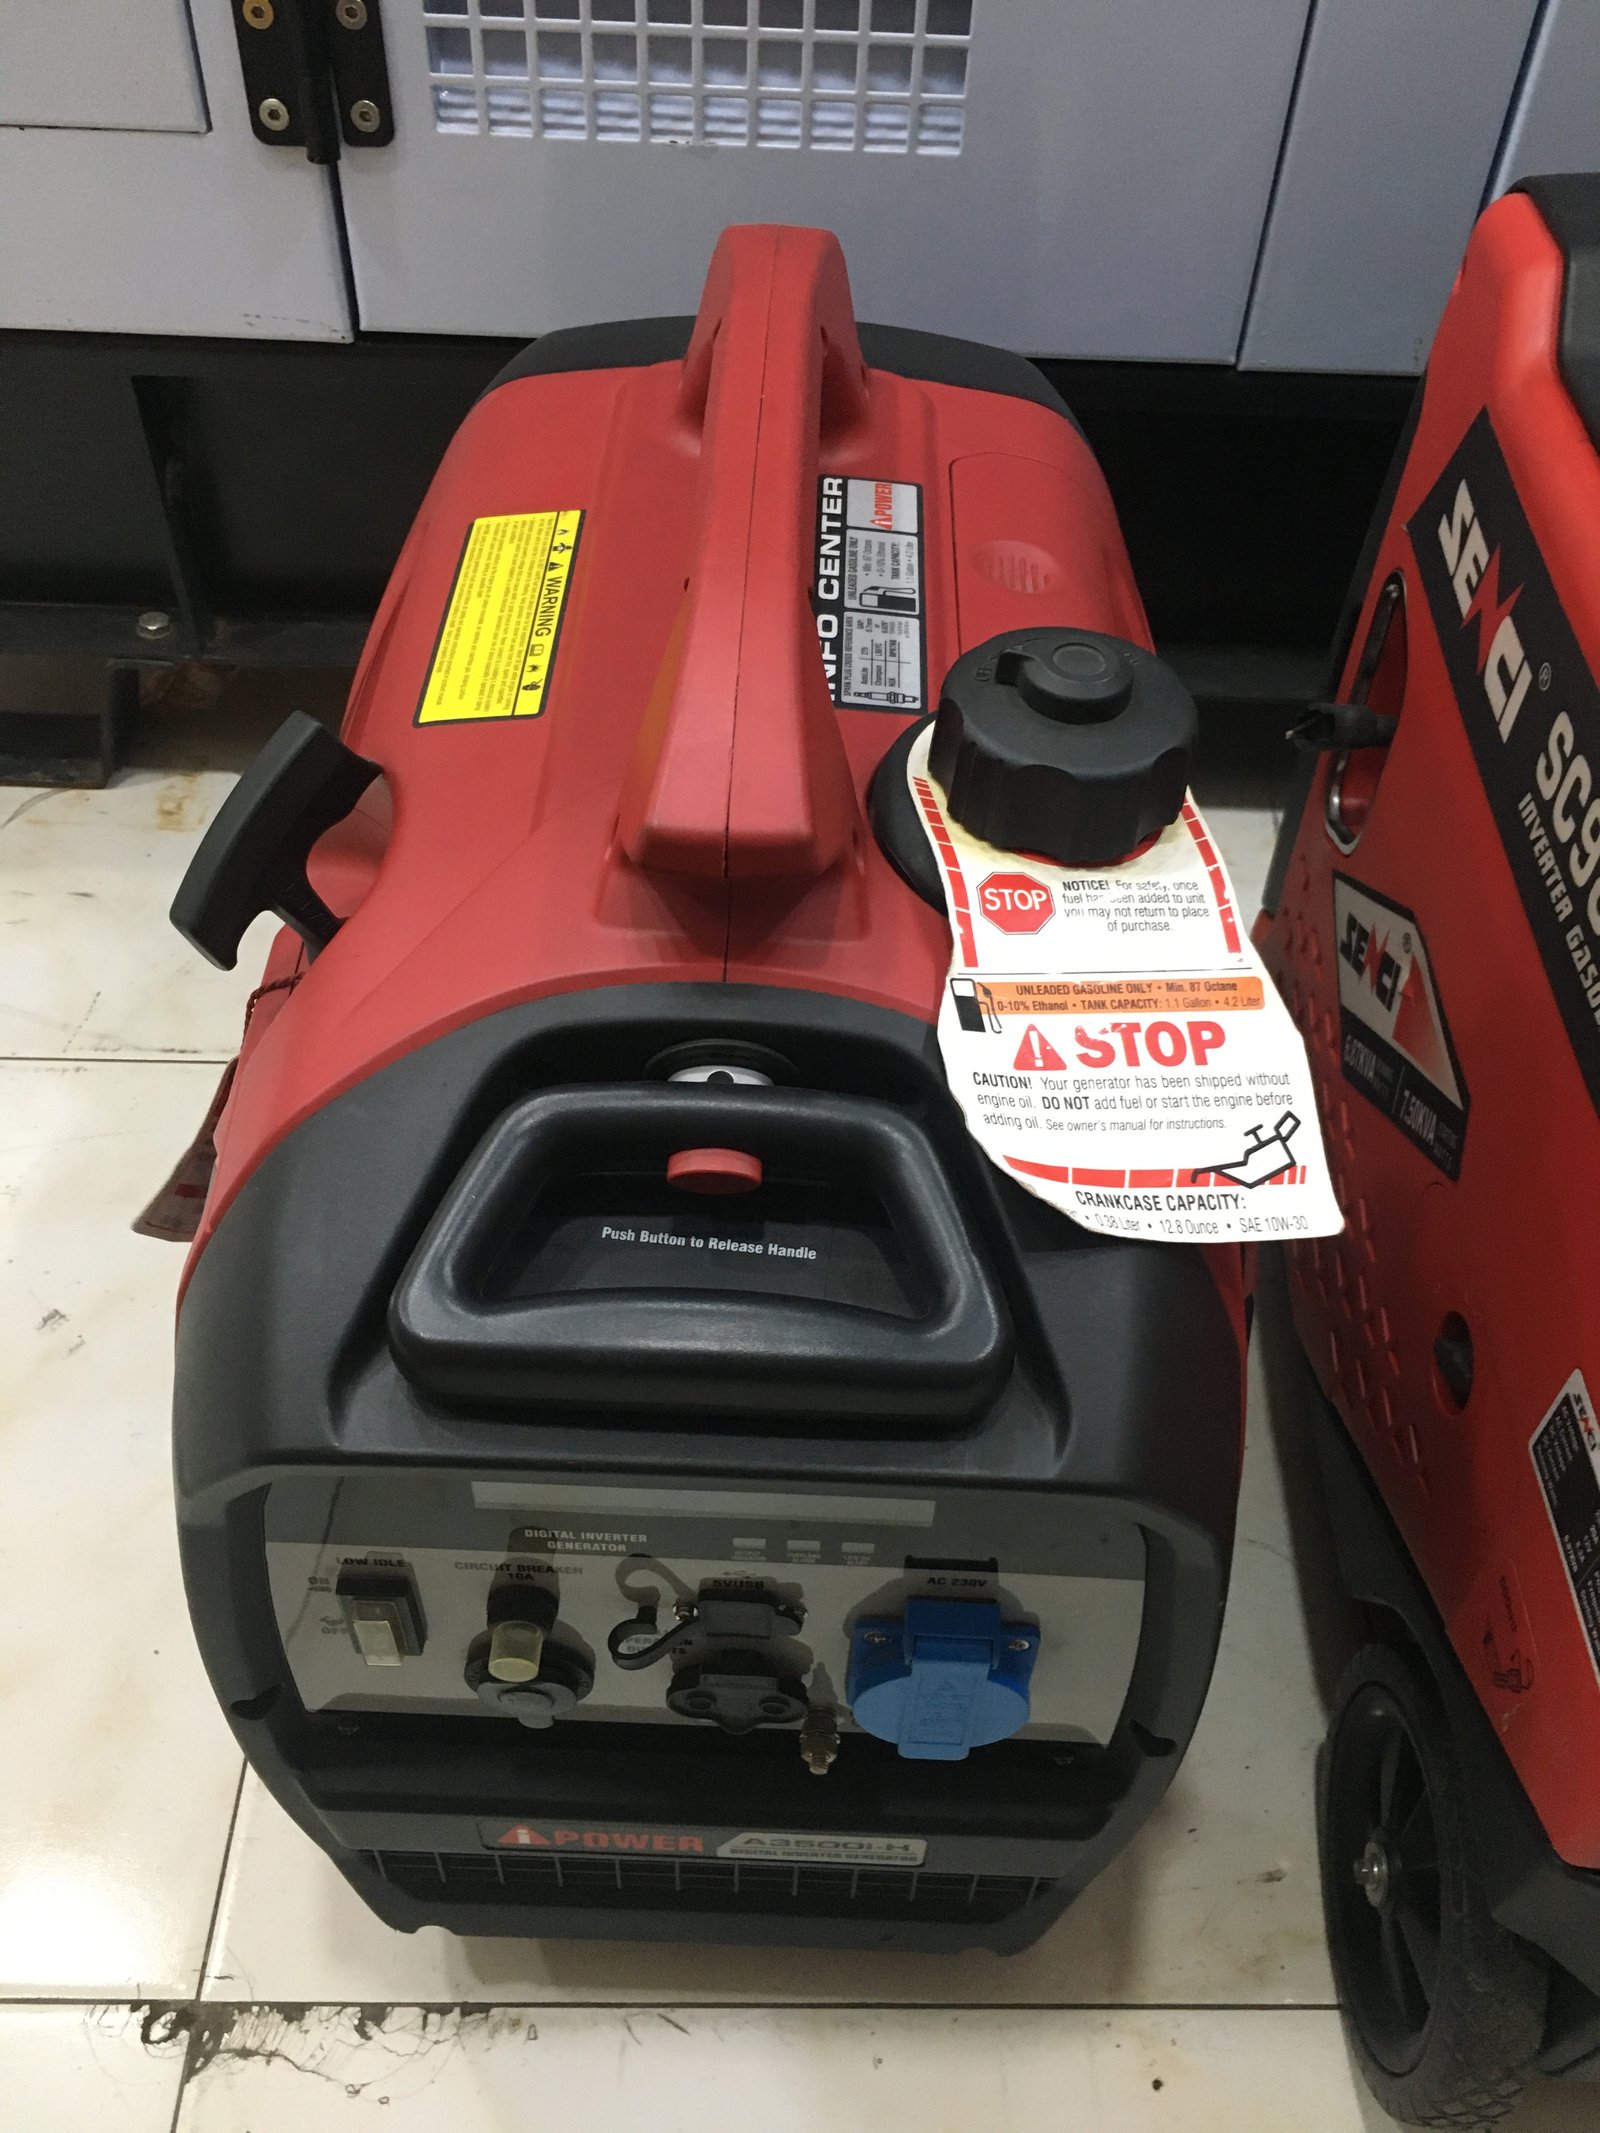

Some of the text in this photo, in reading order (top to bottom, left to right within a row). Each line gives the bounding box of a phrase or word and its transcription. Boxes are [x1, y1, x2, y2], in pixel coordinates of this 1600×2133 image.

[818, 477, 843, 600] CENTER
[535, 576, 563, 637] WARNING
[1437, 478, 1533, 744] SENCI
[1518, 792, 1573, 922] INVERTER
[1062, 880, 1110, 892] NOTICE!
[1173, 882, 1199, 891] once
[984, 888, 1048, 911] STOP
[1062, 893, 1082, 904] fuel
[1138, 893, 1170, 904] added
[1172, 893, 1183, 904] to
[1185, 893, 1205, 904] unit
[1088, 908, 1111, 920] may
[1114, 908, 1132, 918] not
[1134, 908, 1166, 918] return
[1168, 908, 1179, 918] to
[1182, 907, 1210, 920] place
[1108, 920, 1118, 932] of
[1340, 912, 1402, 1013] SENCI
[1016, 981, 1238, 996] UNLEADED GASOLINE ONLY Min. 87 Octane
[997, 996, 1261, 1012] 0-10% Ethanol TANK CAPACITY: 1.1 Gallon 4.2 Liter
[1075, 1021, 1226, 1068] STOP
[973, 1072, 1290, 1092] CAUTION! Your generator has been shipped without
[978, 1092, 1293, 1110] engine oil. DO NOT add fuel or start the engine before
[983, 1113, 1227, 1132] adding oil. See owner's manual for instructions.
[1075, 1190, 1246, 1212] CRANKCASE CAPACITY:
[1094, 1214, 1116, 1229] 0.38
[1120, 1216, 1140, 1232] Liter
[1160, 1220, 1183, 1234] 12.8
[1186, 1220, 1218, 1234] Ounce
[1240, 1217, 1263, 1233] SAE
[1266, 1215, 1308, 1232] 10W-30
[602, 1226, 817, 1260] Push Button to Release Handle
[524, 1529, 648, 1543] DIGITAL INVERTER
[547, 1540, 628, 1552] GENERATOR
[336, 1557, 406, 1568] LOW IDLE
[454, 1561, 584, 1575] CIRCUIT BREAKER
[507, 1572, 534, 1581] 10A
[927, 1576, 946, 1586] AC
